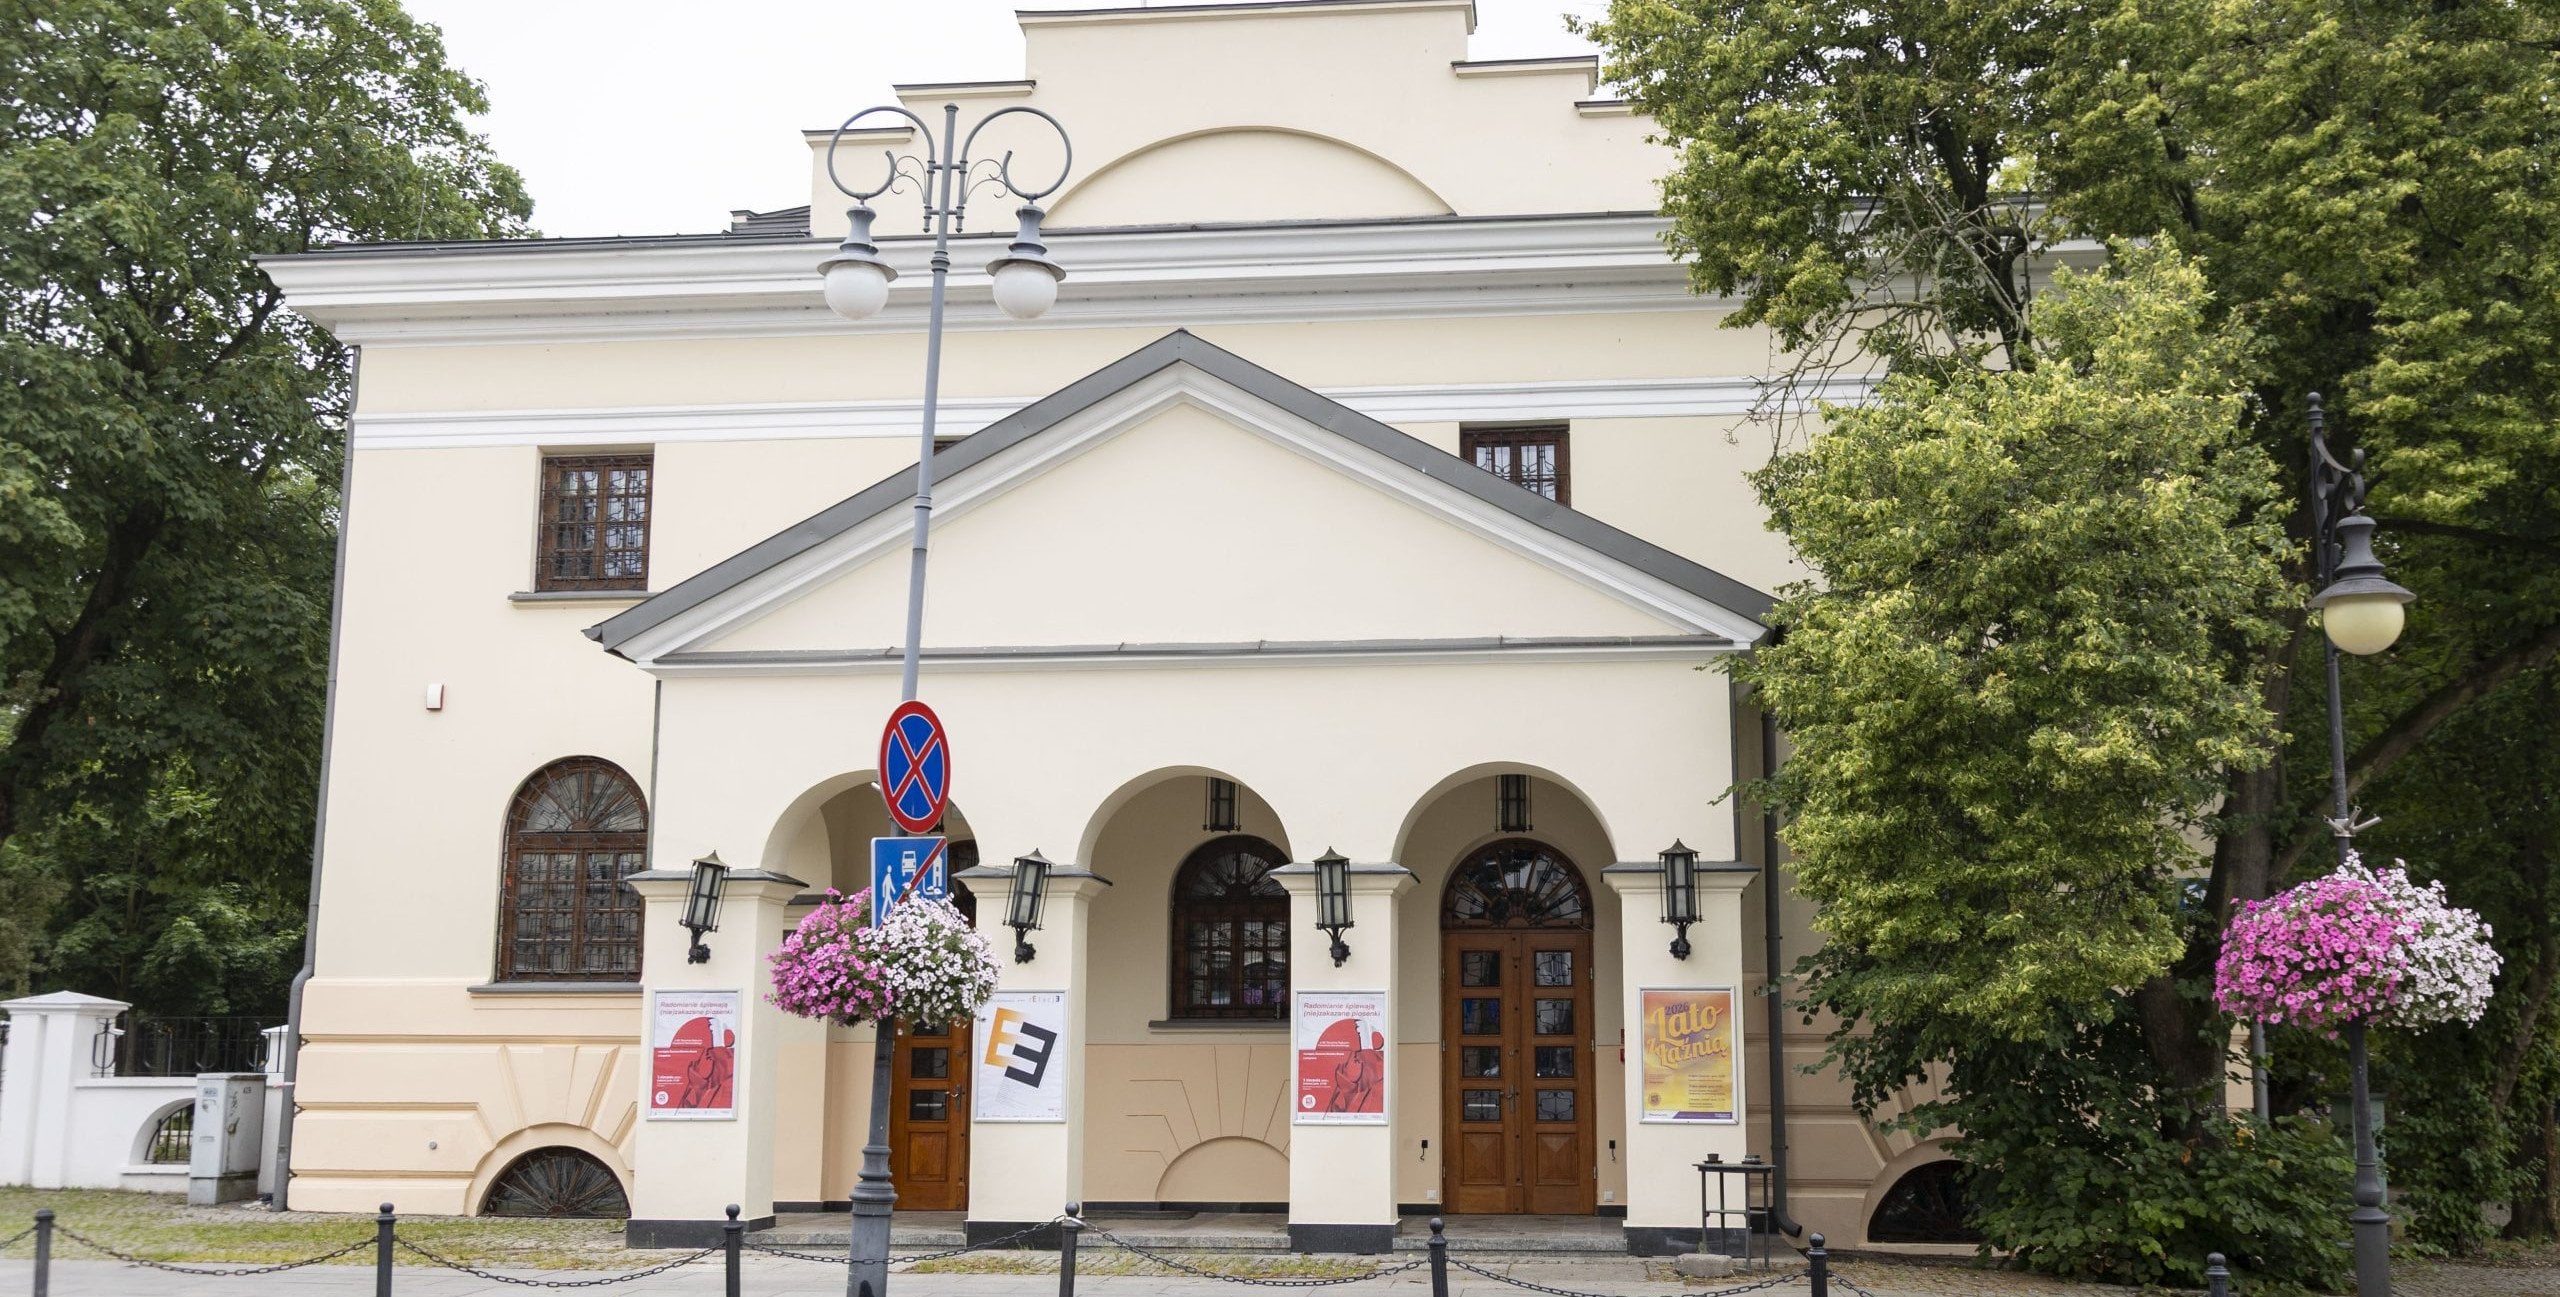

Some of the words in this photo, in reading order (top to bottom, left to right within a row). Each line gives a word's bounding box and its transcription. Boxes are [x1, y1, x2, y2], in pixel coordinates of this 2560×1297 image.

[1345, 1002, 1375, 1010] śpiewają
[1665, 1002, 1690, 1015] 2026
[1303, 1010, 1350, 1018] (nie)zakazane
[1649, 1003, 1724, 1047] Lato
